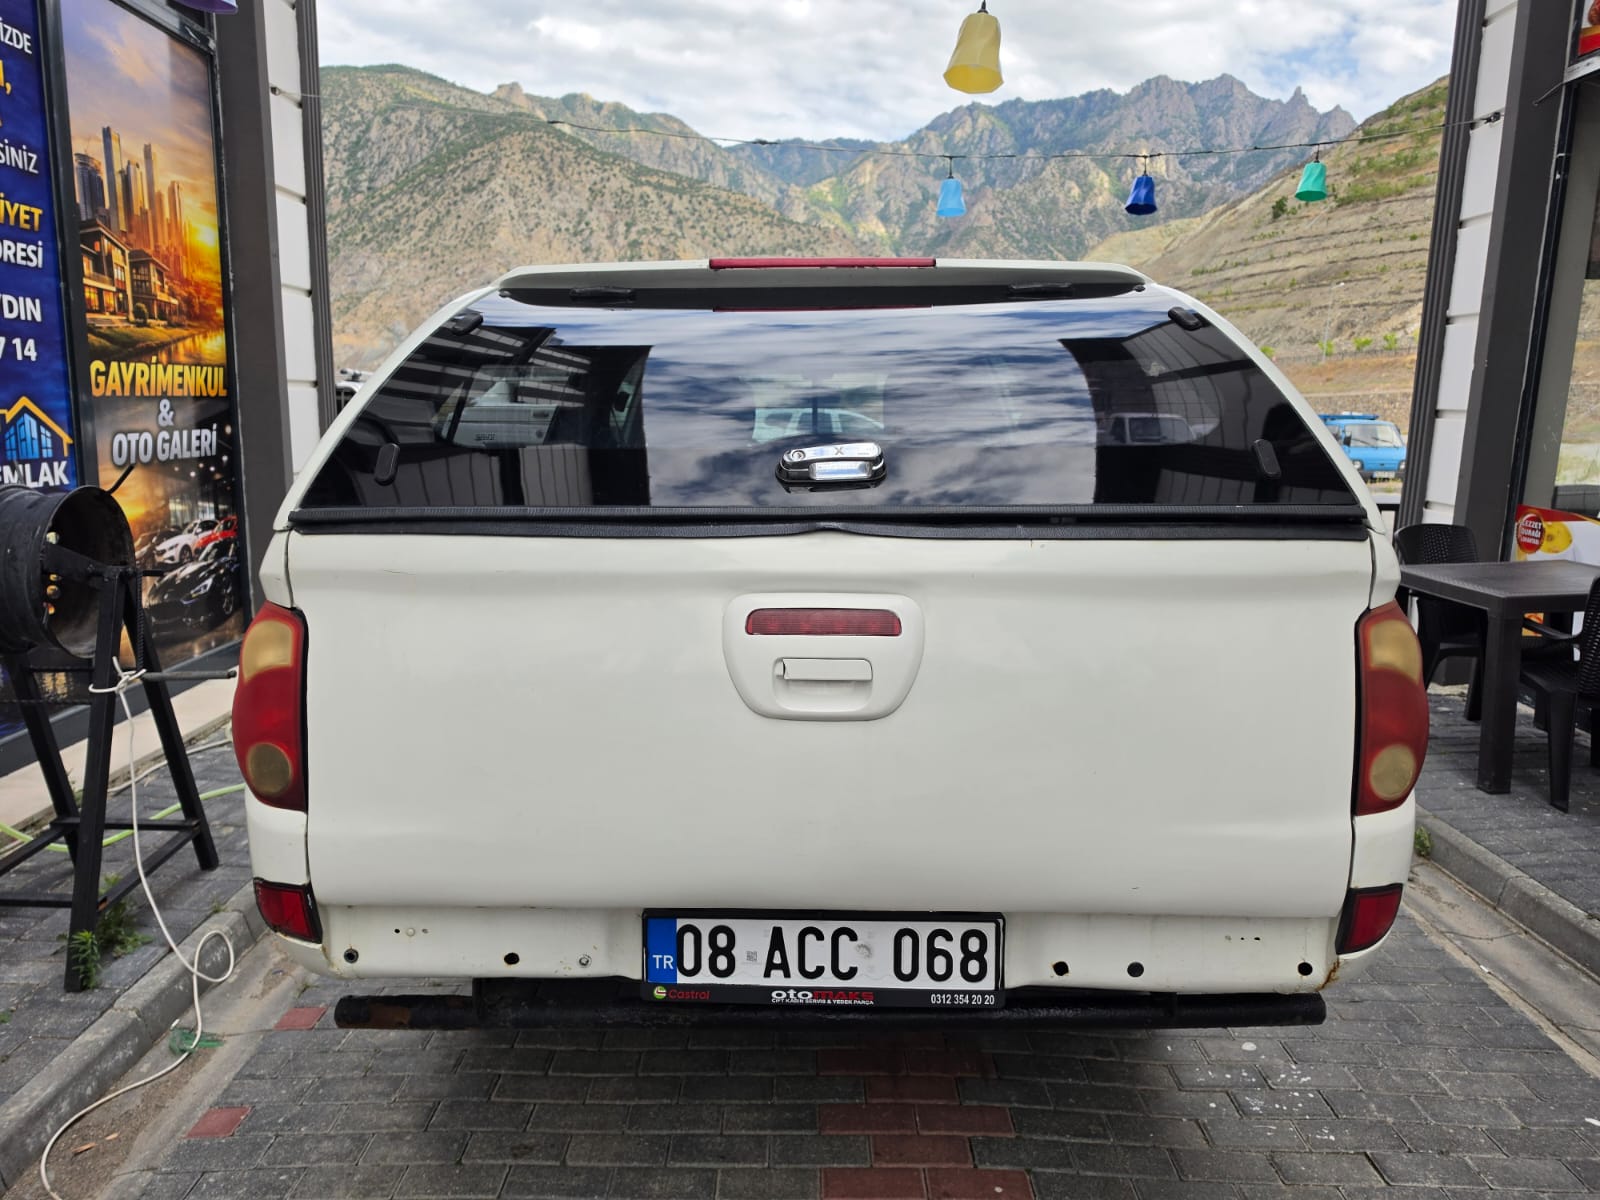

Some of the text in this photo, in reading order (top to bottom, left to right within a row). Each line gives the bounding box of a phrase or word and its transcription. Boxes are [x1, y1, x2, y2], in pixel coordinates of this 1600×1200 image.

[0, 240, 43, 269] RESİ
[0, 294, 42, 322] DIN
[12, 338, 37, 361] 14
[90, 355, 227, 397] GAYRİMENKUL
[158, 399, 174, 427] &
[112, 423, 217, 466] OTO GALERİ
[0, 461, 70, 488] MLAK
[652, 954, 674, 970] TR
[676, 924, 988, 983] 08 ACC 068
[668, 989, 710, 999] Castrol
[930, 994, 995, 1005] 0312 354 20 20
